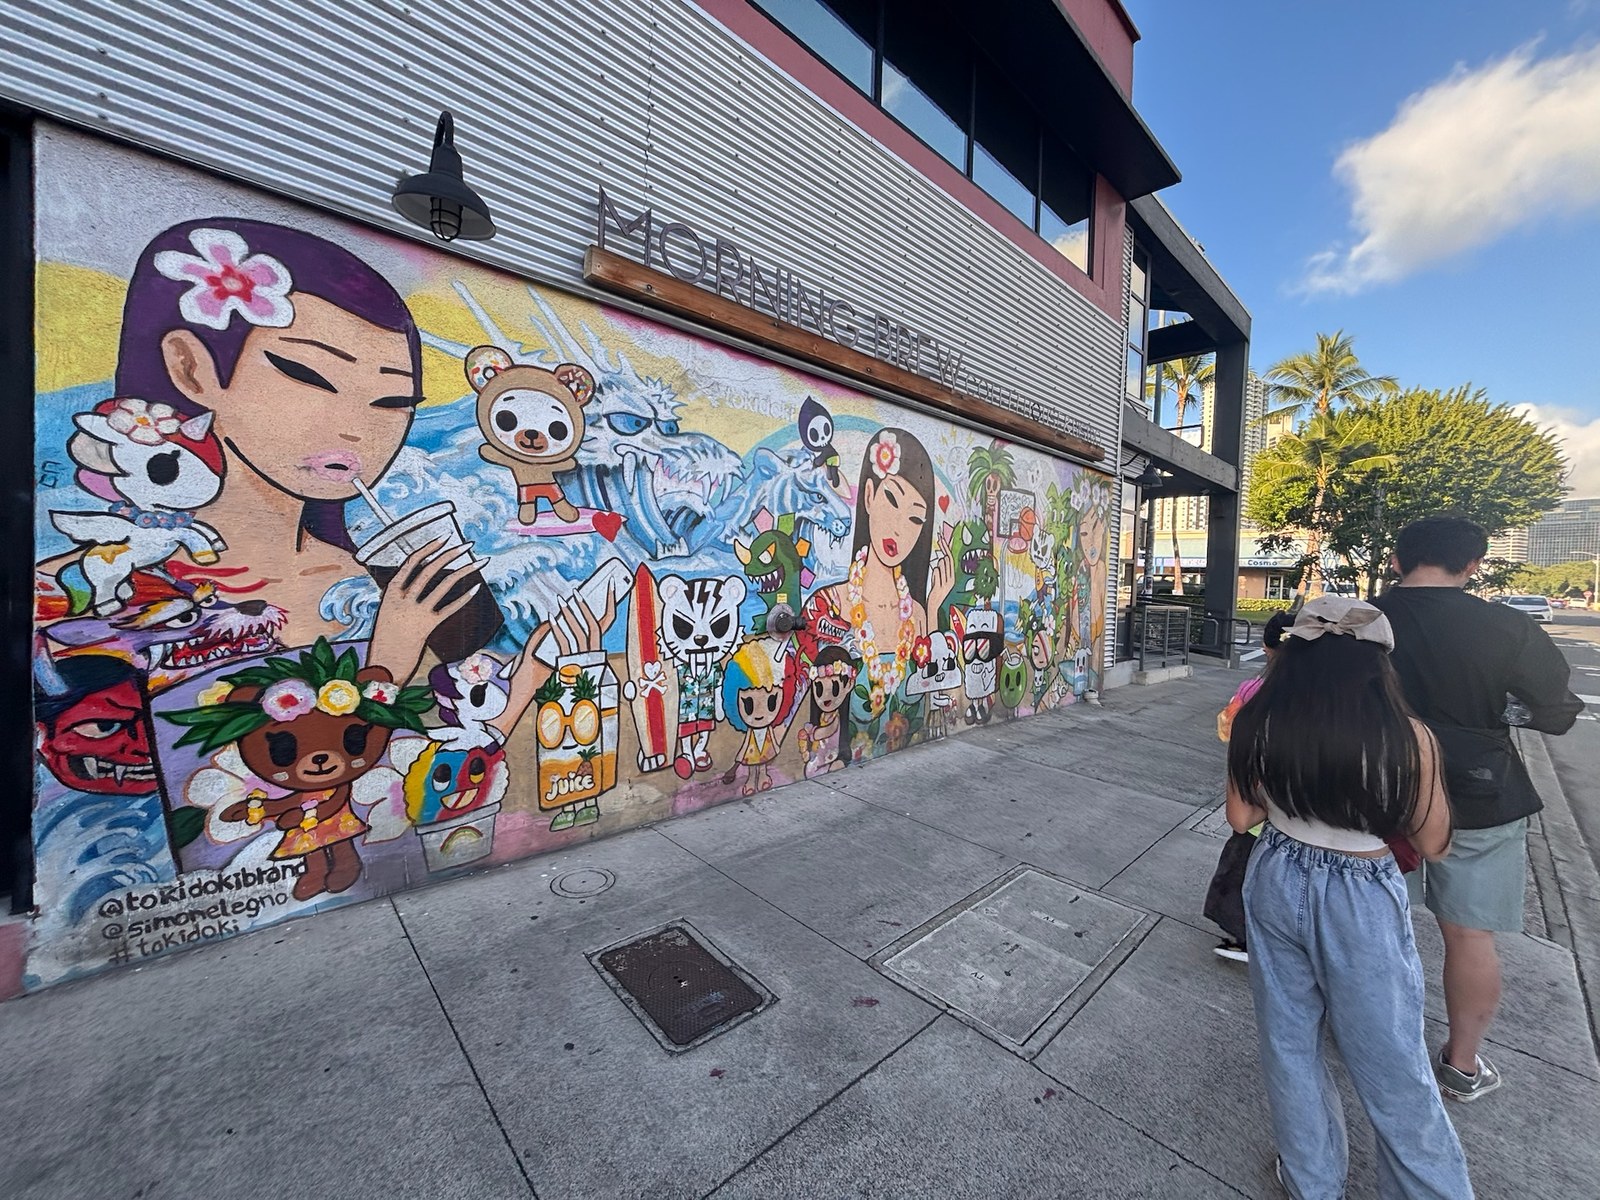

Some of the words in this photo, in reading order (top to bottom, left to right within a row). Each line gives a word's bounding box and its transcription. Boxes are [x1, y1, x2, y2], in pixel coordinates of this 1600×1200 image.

[598, 184, 860, 347] MORNING
[874, 312, 963, 392] BREW
[98, 860, 309, 919] @tokidokibrand
[102, 892, 289, 940] @simonelegno
[108, 919, 240, 965] #tokidoki
